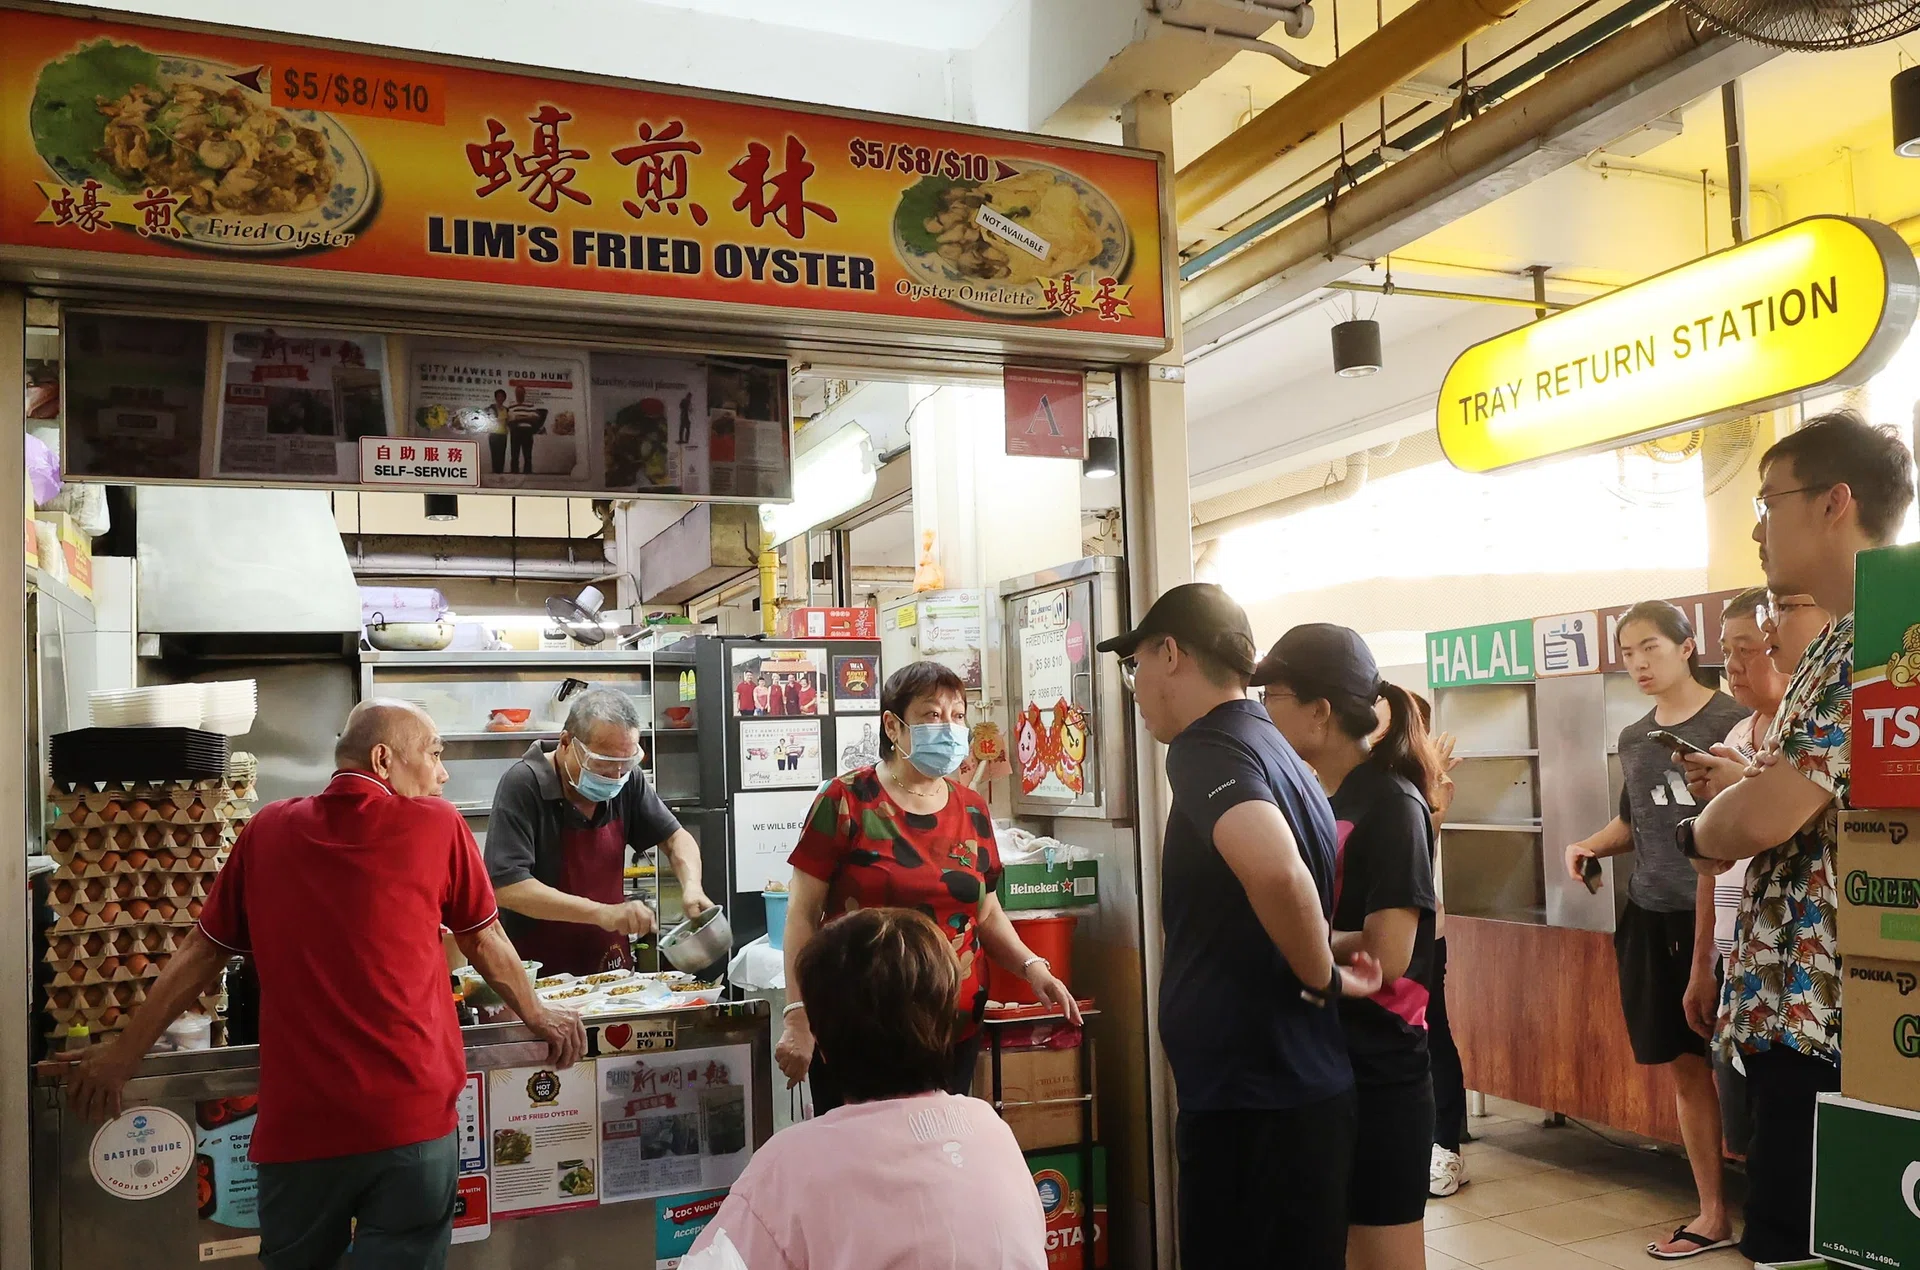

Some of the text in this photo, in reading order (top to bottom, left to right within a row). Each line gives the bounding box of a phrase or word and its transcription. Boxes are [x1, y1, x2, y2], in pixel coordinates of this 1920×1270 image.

[283, 67, 430, 114] $5/$8/$10
[849, 138, 989, 182] $5/$8/$10
[207, 218, 355, 250] Fried Oyster
[982, 212, 1045, 254] NOT AVAILABLE
[428, 216, 876, 291] LIM'S FRIED OYSTER
[895, 279, 1035, 307] Oyster Omelette
[1458, 275, 1840, 426] TRAY RETURN STATION
[420, 364, 571, 380] CITY HAWKER FOOD HUNT
[1024, 393, 1065, 437] A
[376, 444, 463, 463] 自助服務
[374, 464, 468, 479] SELF-SERVICE
[1025, 630, 1065, 648] FRIED OYSTER
[1035, 655, 1063, 671] $5 $8 $10
[1430, 628, 1530, 684] HALAL
[1028, 690, 1037, 701] HP
[752, 823, 766, 831] WE
[766, 822, 785, 830] WILL
[786, 822, 797, 830] BE
[1843, 821, 1886, 834] POKKA
[1010, 881, 1060, 895] Heineken
[1850, 967, 1894, 983] POKKA
[585, 1026, 602, 1058] I
[636, 1030, 674, 1039] HAWKER
[508, 1109, 579, 1122] LIM'S FRIED OYSTER
[126, 1128, 156, 1139] CLASS
[150, 1141, 182, 1154] GUIDE
[151, 1165, 181, 1188] CHOICE
[465, 1186, 482, 1194] WITH
[674, 1207, 693, 1218] CDC
